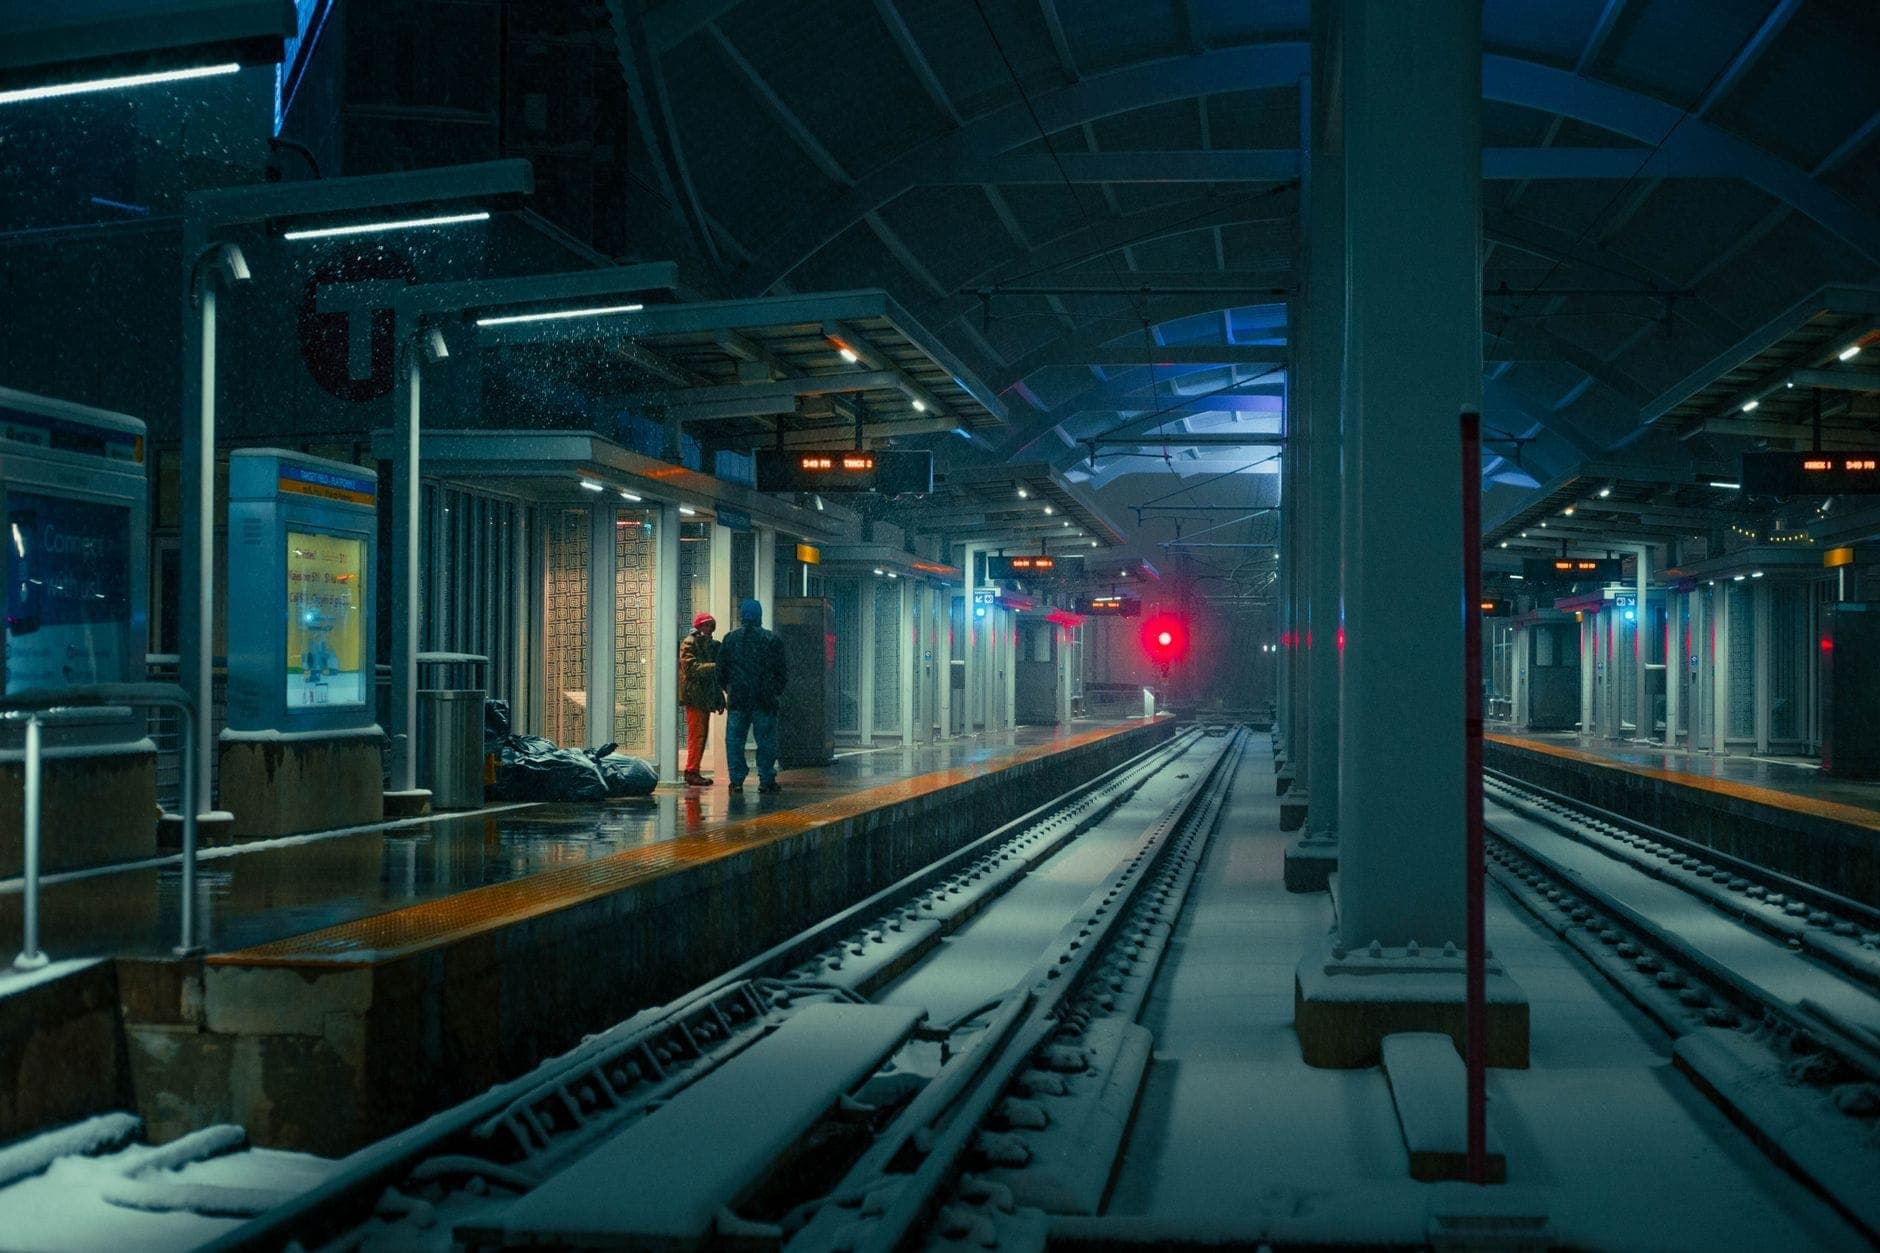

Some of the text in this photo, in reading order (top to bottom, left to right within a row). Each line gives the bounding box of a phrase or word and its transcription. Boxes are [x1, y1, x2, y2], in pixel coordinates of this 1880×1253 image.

[820, 459, 831, 468] PM
[843, 459, 865, 468] TRACK
[44, 523, 105, 558] Connect
[47, 570, 78, 598] with
